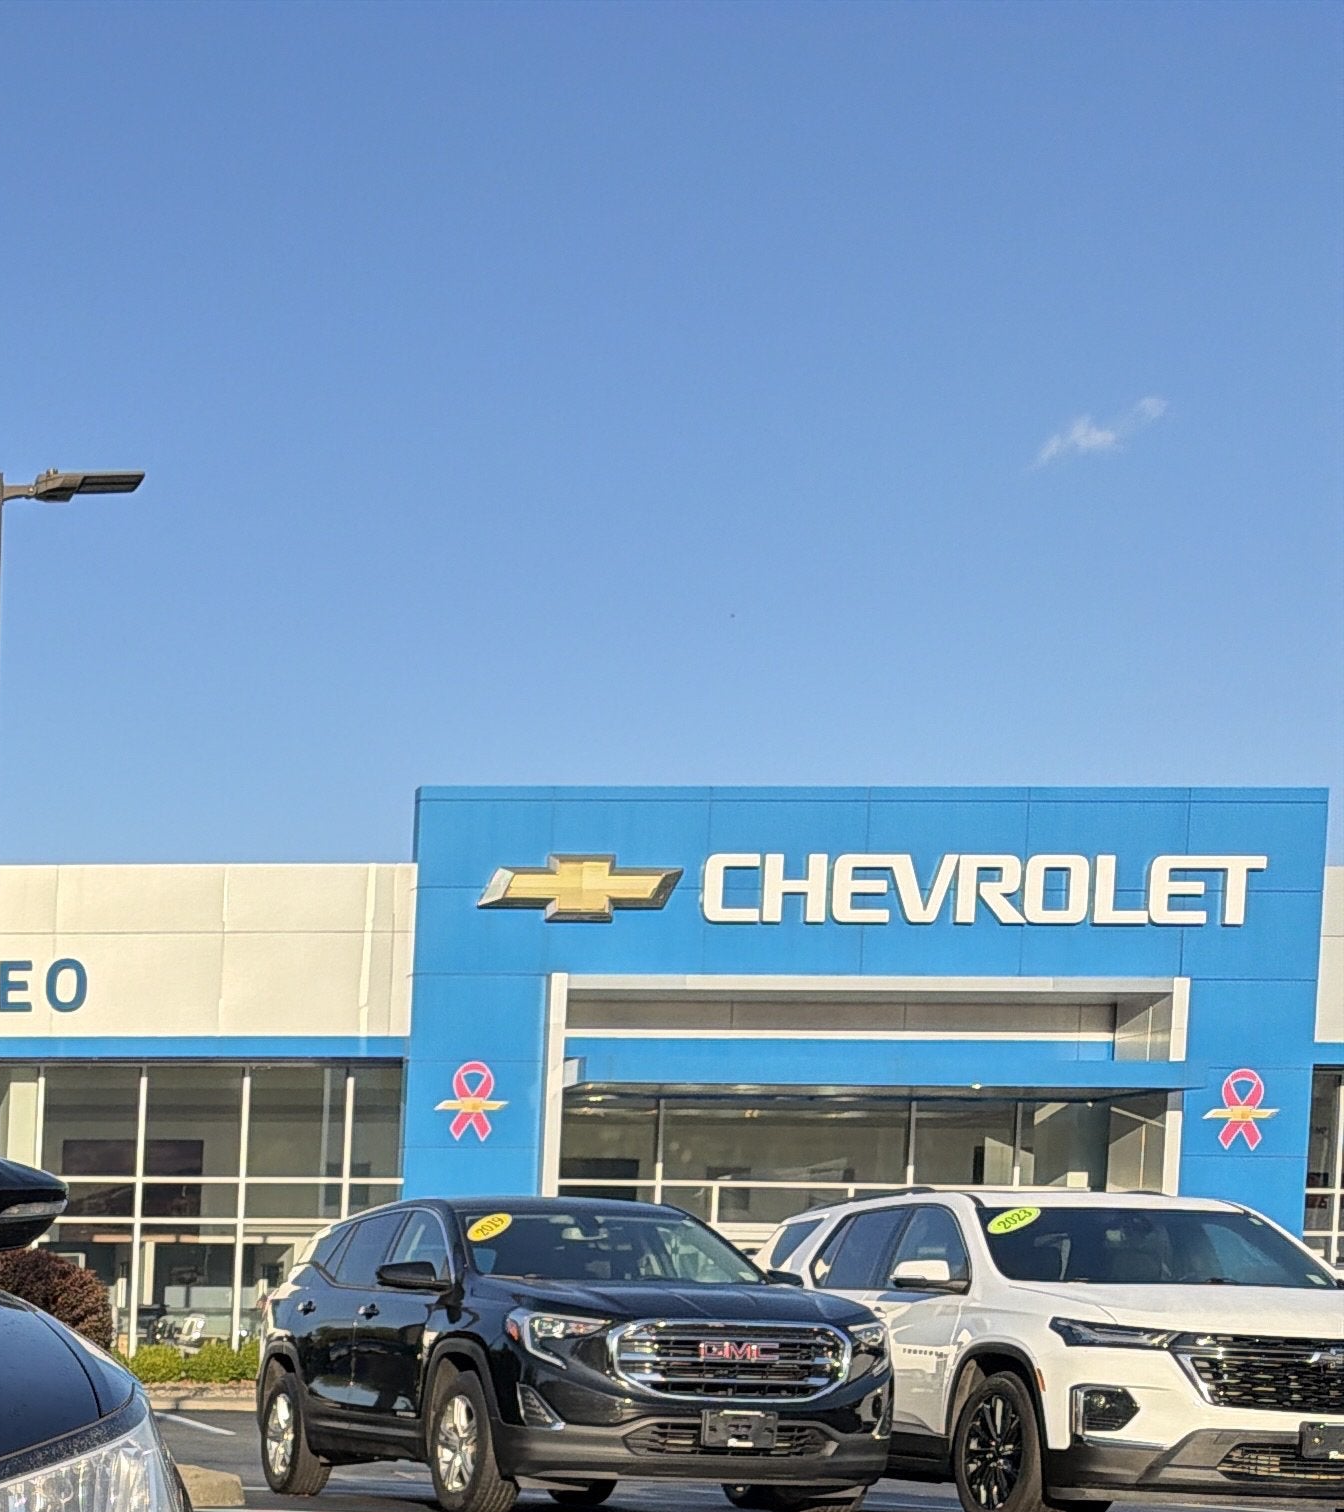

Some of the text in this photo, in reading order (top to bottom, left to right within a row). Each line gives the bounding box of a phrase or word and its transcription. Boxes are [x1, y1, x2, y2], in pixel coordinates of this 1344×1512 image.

[703, 853, 1268, 926] CHEVROLET
[475, 1216, 505, 1237] 2019
[997, 1209, 1033, 1229] 2023
[699, 1341, 780, 1361] GMC
